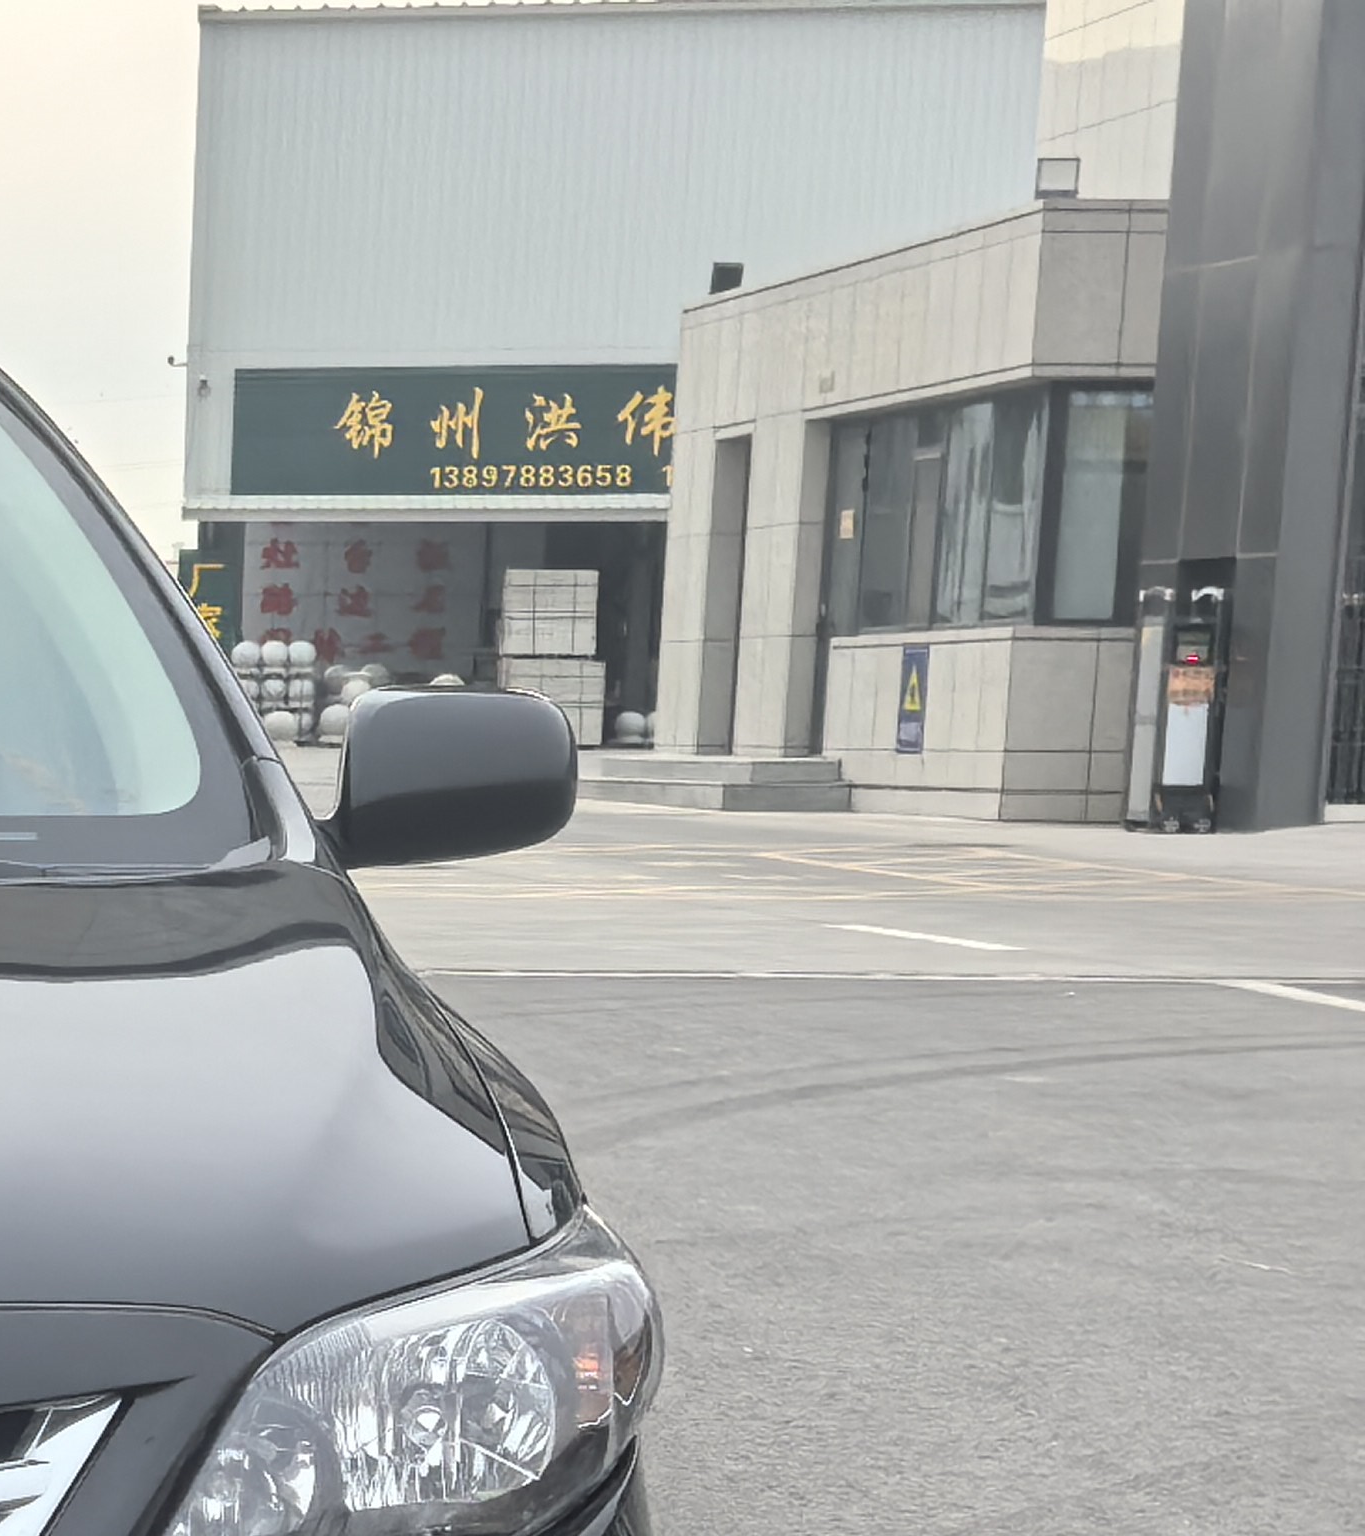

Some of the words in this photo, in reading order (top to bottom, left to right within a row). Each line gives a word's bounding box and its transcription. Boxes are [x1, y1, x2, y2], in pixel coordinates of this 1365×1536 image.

[334, 386, 674, 460] 锦州洪伟
[429, 464, 633, 489] 13897883658
